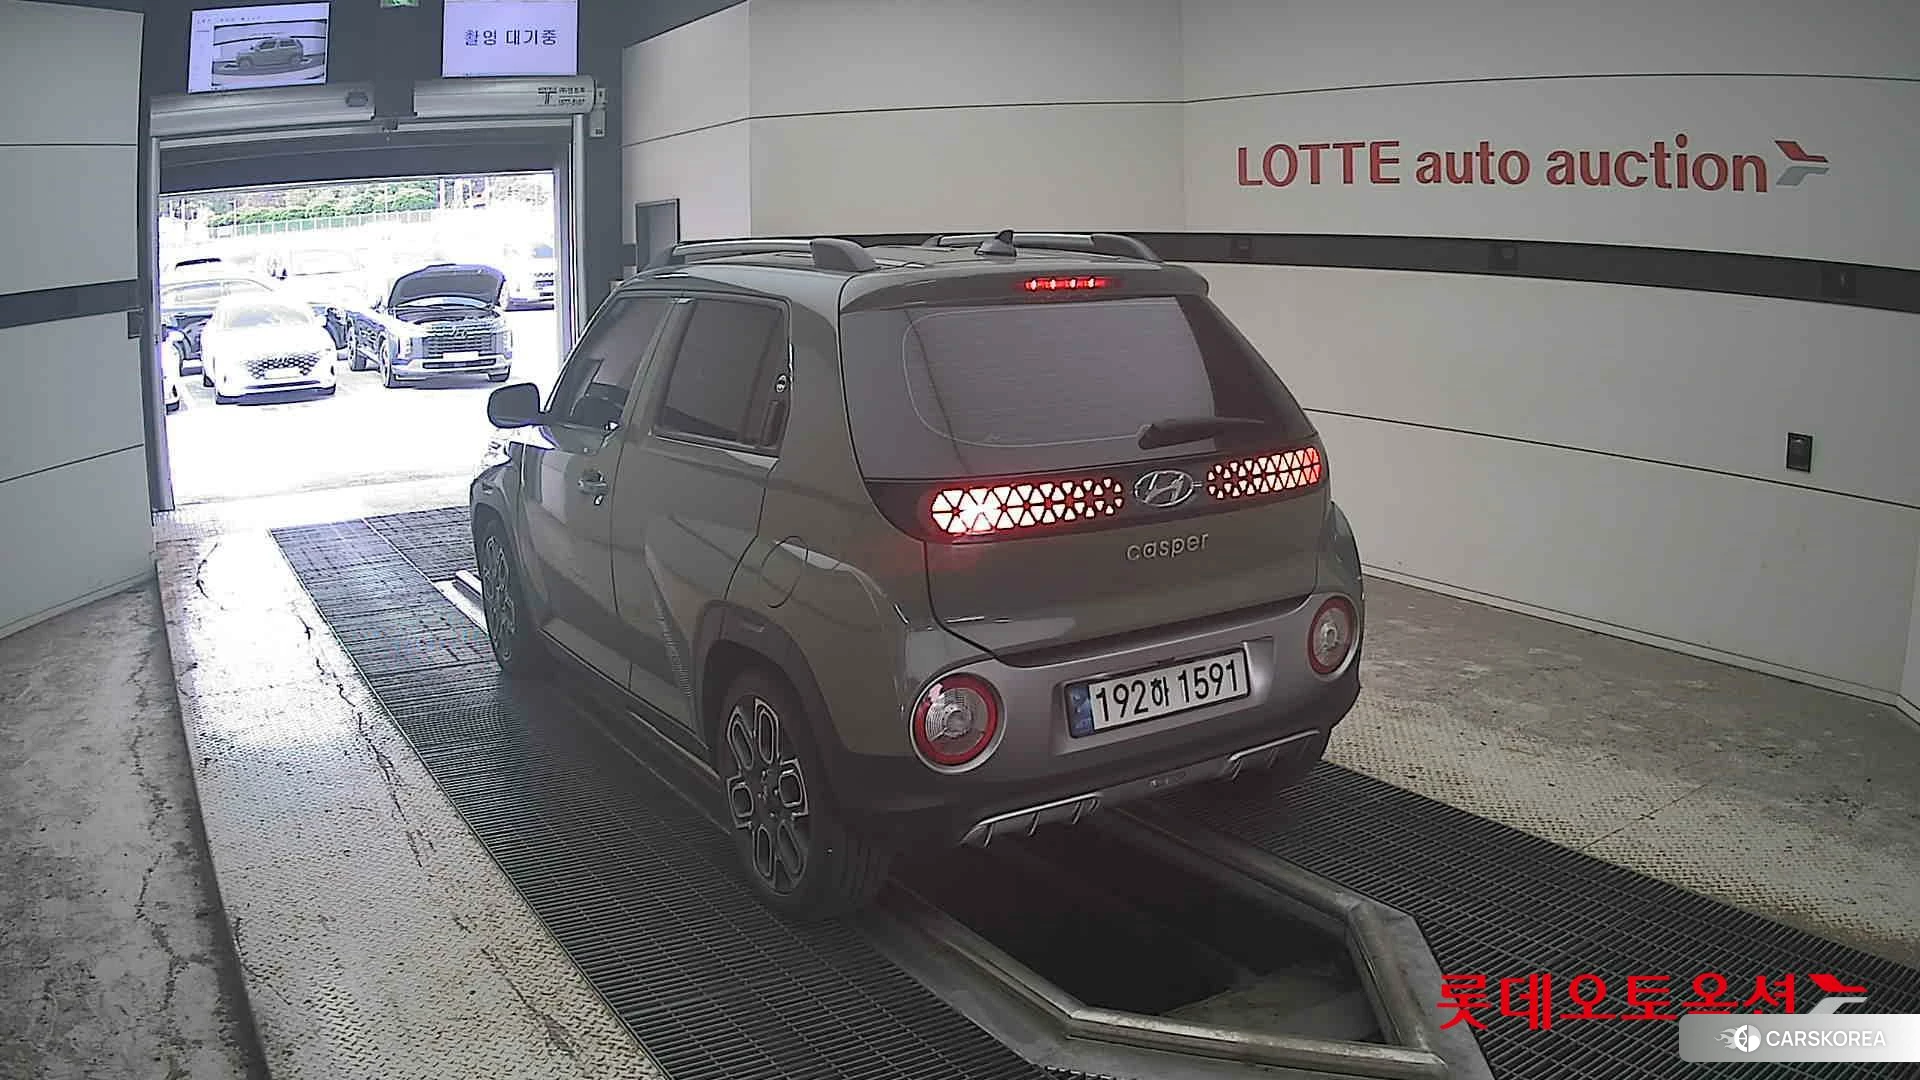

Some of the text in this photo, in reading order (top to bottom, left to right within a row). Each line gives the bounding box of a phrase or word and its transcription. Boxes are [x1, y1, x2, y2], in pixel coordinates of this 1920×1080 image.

[506, 29, 557, 46] 대기중
[1236, 133, 1768, 193] LOTTE auto auction
[1126, 533, 1209, 561] casper
[1095, 659, 1238, 722] 192하 1591
